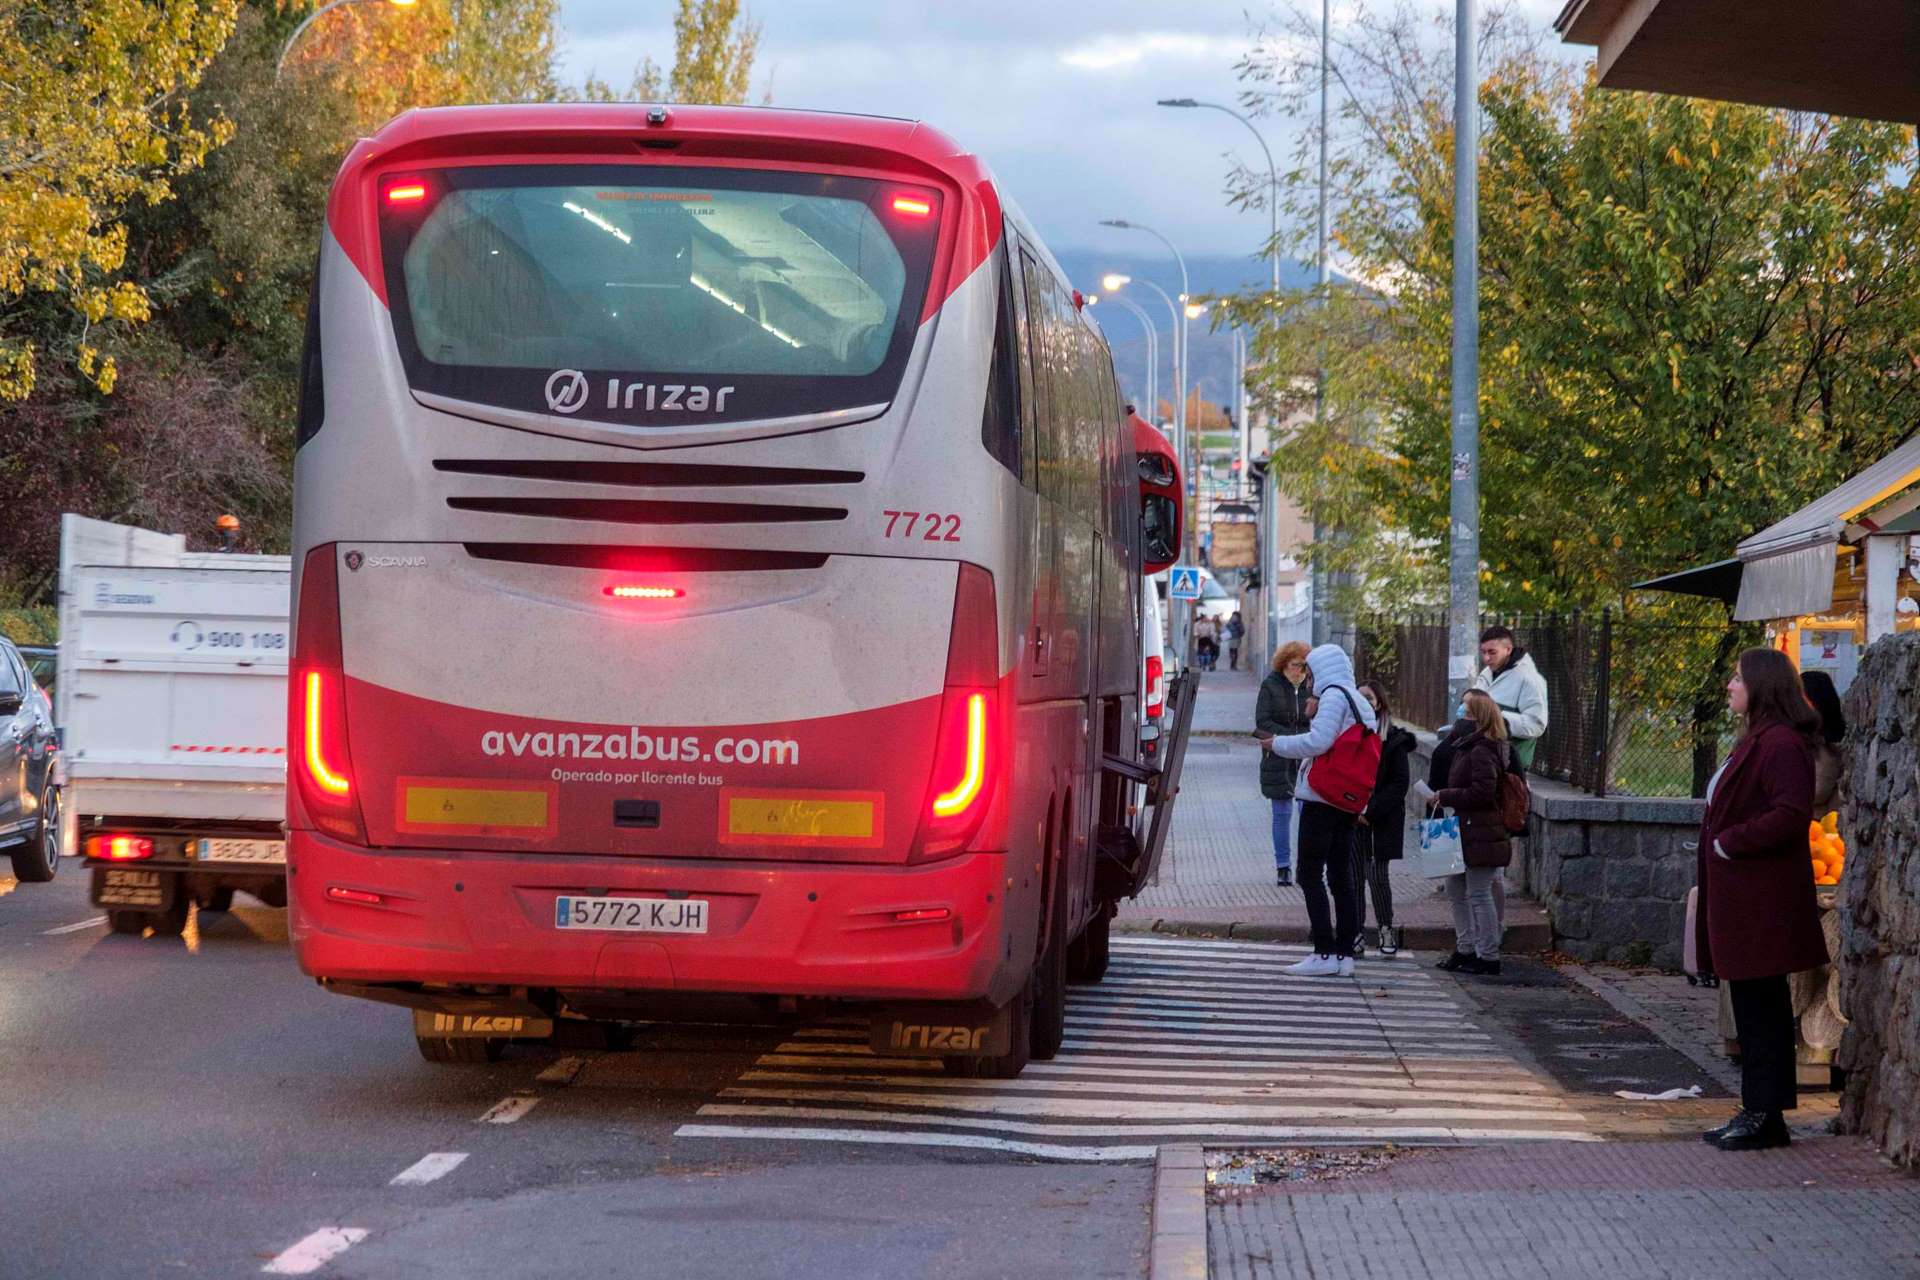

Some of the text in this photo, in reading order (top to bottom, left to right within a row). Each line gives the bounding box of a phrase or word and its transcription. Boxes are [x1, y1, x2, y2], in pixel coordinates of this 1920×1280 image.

[607, 379, 734, 412] Irizar
[883, 510, 961, 542] 7722
[367, 556, 428, 568] SCANIA
[208, 631, 244, 648] 900
[481, 727, 799, 765] avanzabus.com
[551, 767, 723, 785] Operado por llorente bus
[574, 901, 700, 928] 5772 KJH
[890, 1022, 989, 1050] Irizar
